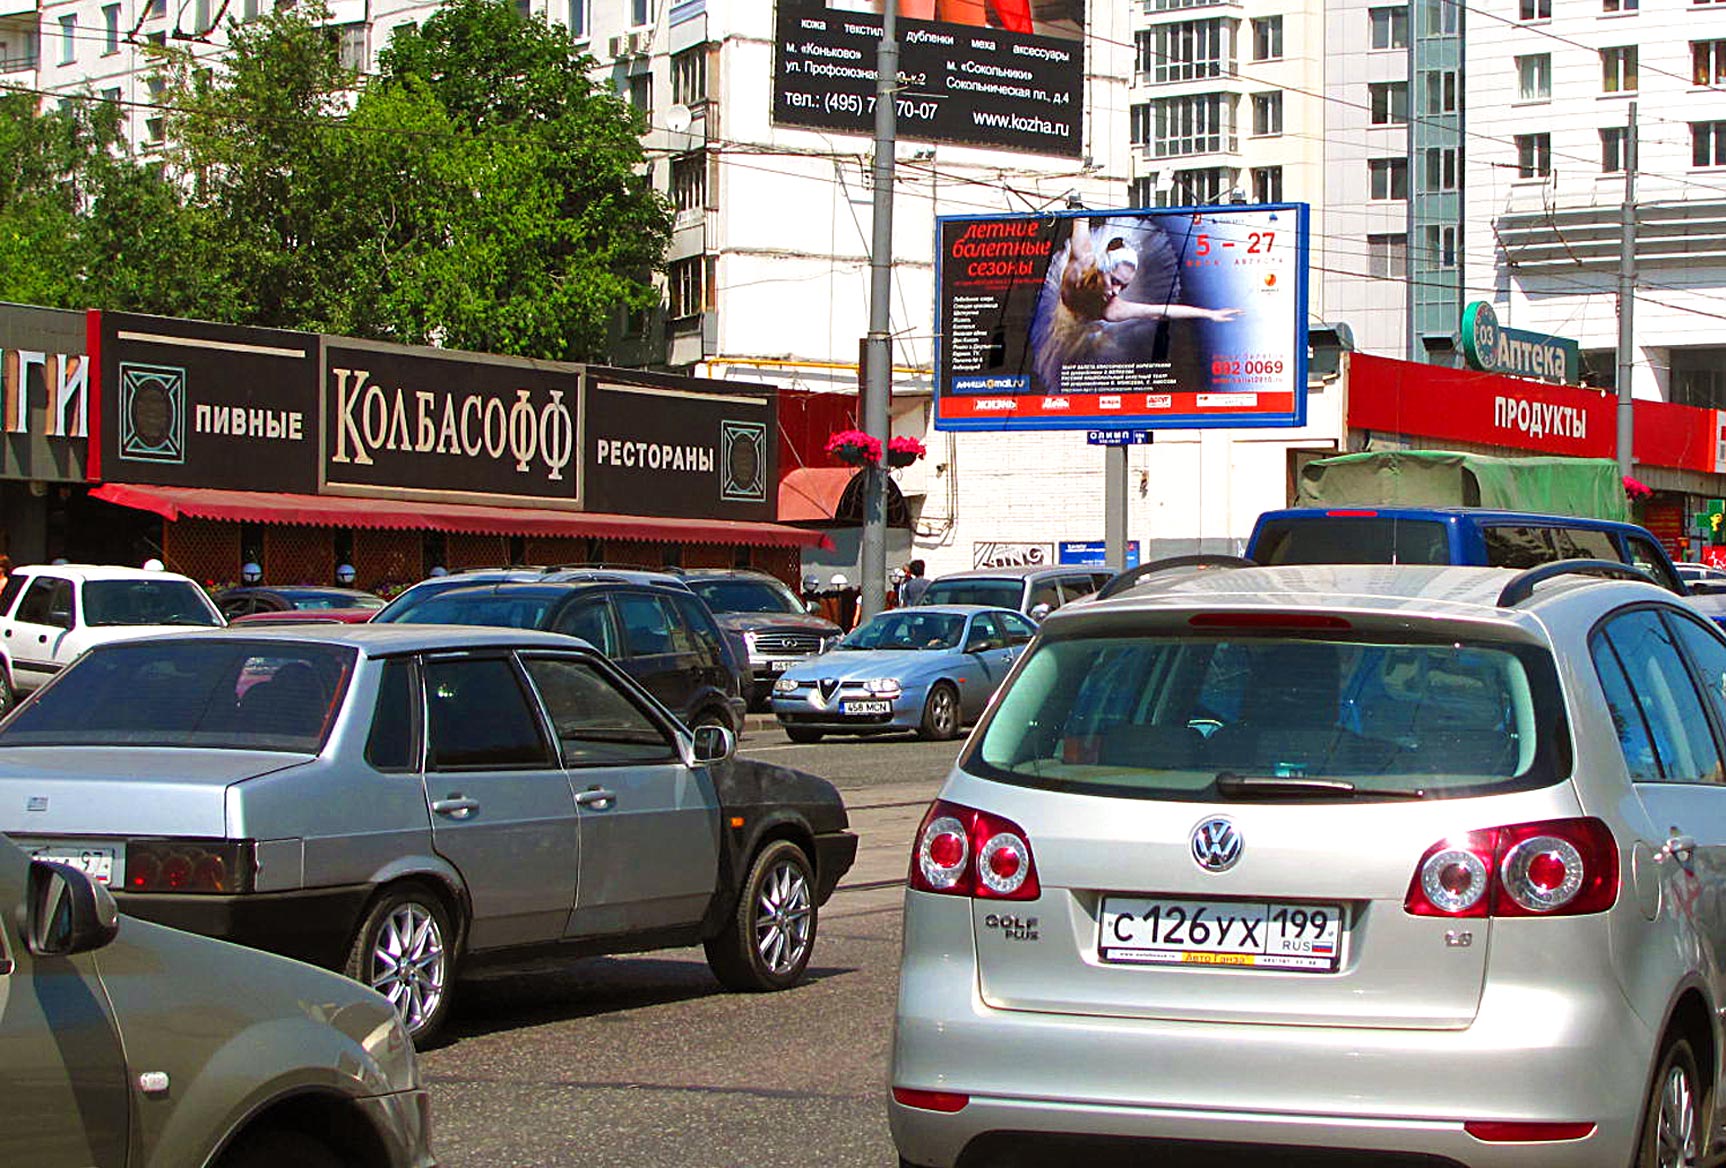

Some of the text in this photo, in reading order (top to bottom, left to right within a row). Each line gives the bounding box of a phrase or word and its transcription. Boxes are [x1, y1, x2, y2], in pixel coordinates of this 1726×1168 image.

[801, 19, 1071, 61] кожа текстил дубленки меха аксессуары
[801, 42, 862, 60] «Коньково»
[960, 61, 1034, 80] «Сокольники»
[946, 76, 1031, 99] Сокольническая
[1052, 92, 1069, 105] д.4
[785, 92, 820, 108] тел.:
[824, 92, 863, 117] (495)
[973, 111, 1070, 137] www.kozha.ru
[964, 222, 1039, 239] летние
[952, 239, 1052, 258] балетные
[1195, 233, 1211, 256] 5
[1247, 231, 1276, 254] 27
[968, 260, 1034, 277] сезоны
[1480, 325, 1494, 346] 03
[1244, 359, 1284, 375] 0069
[1498, 332, 1566, 379] Аптека
[0, 348, 90, 438] ГИ
[195, 403, 304, 440] ПИВНЫЕ
[1495, 395, 1587, 439] ПРОДУКТЫ
[596, 439, 714, 473] РЕСТОРАНЫ
[984, 914, 1039, 928] GOLF
[1272, 907, 1329, 939] 199
[1005, 929, 1040, 940] PLUS
[1282, 941, 1311, 951] RUS
